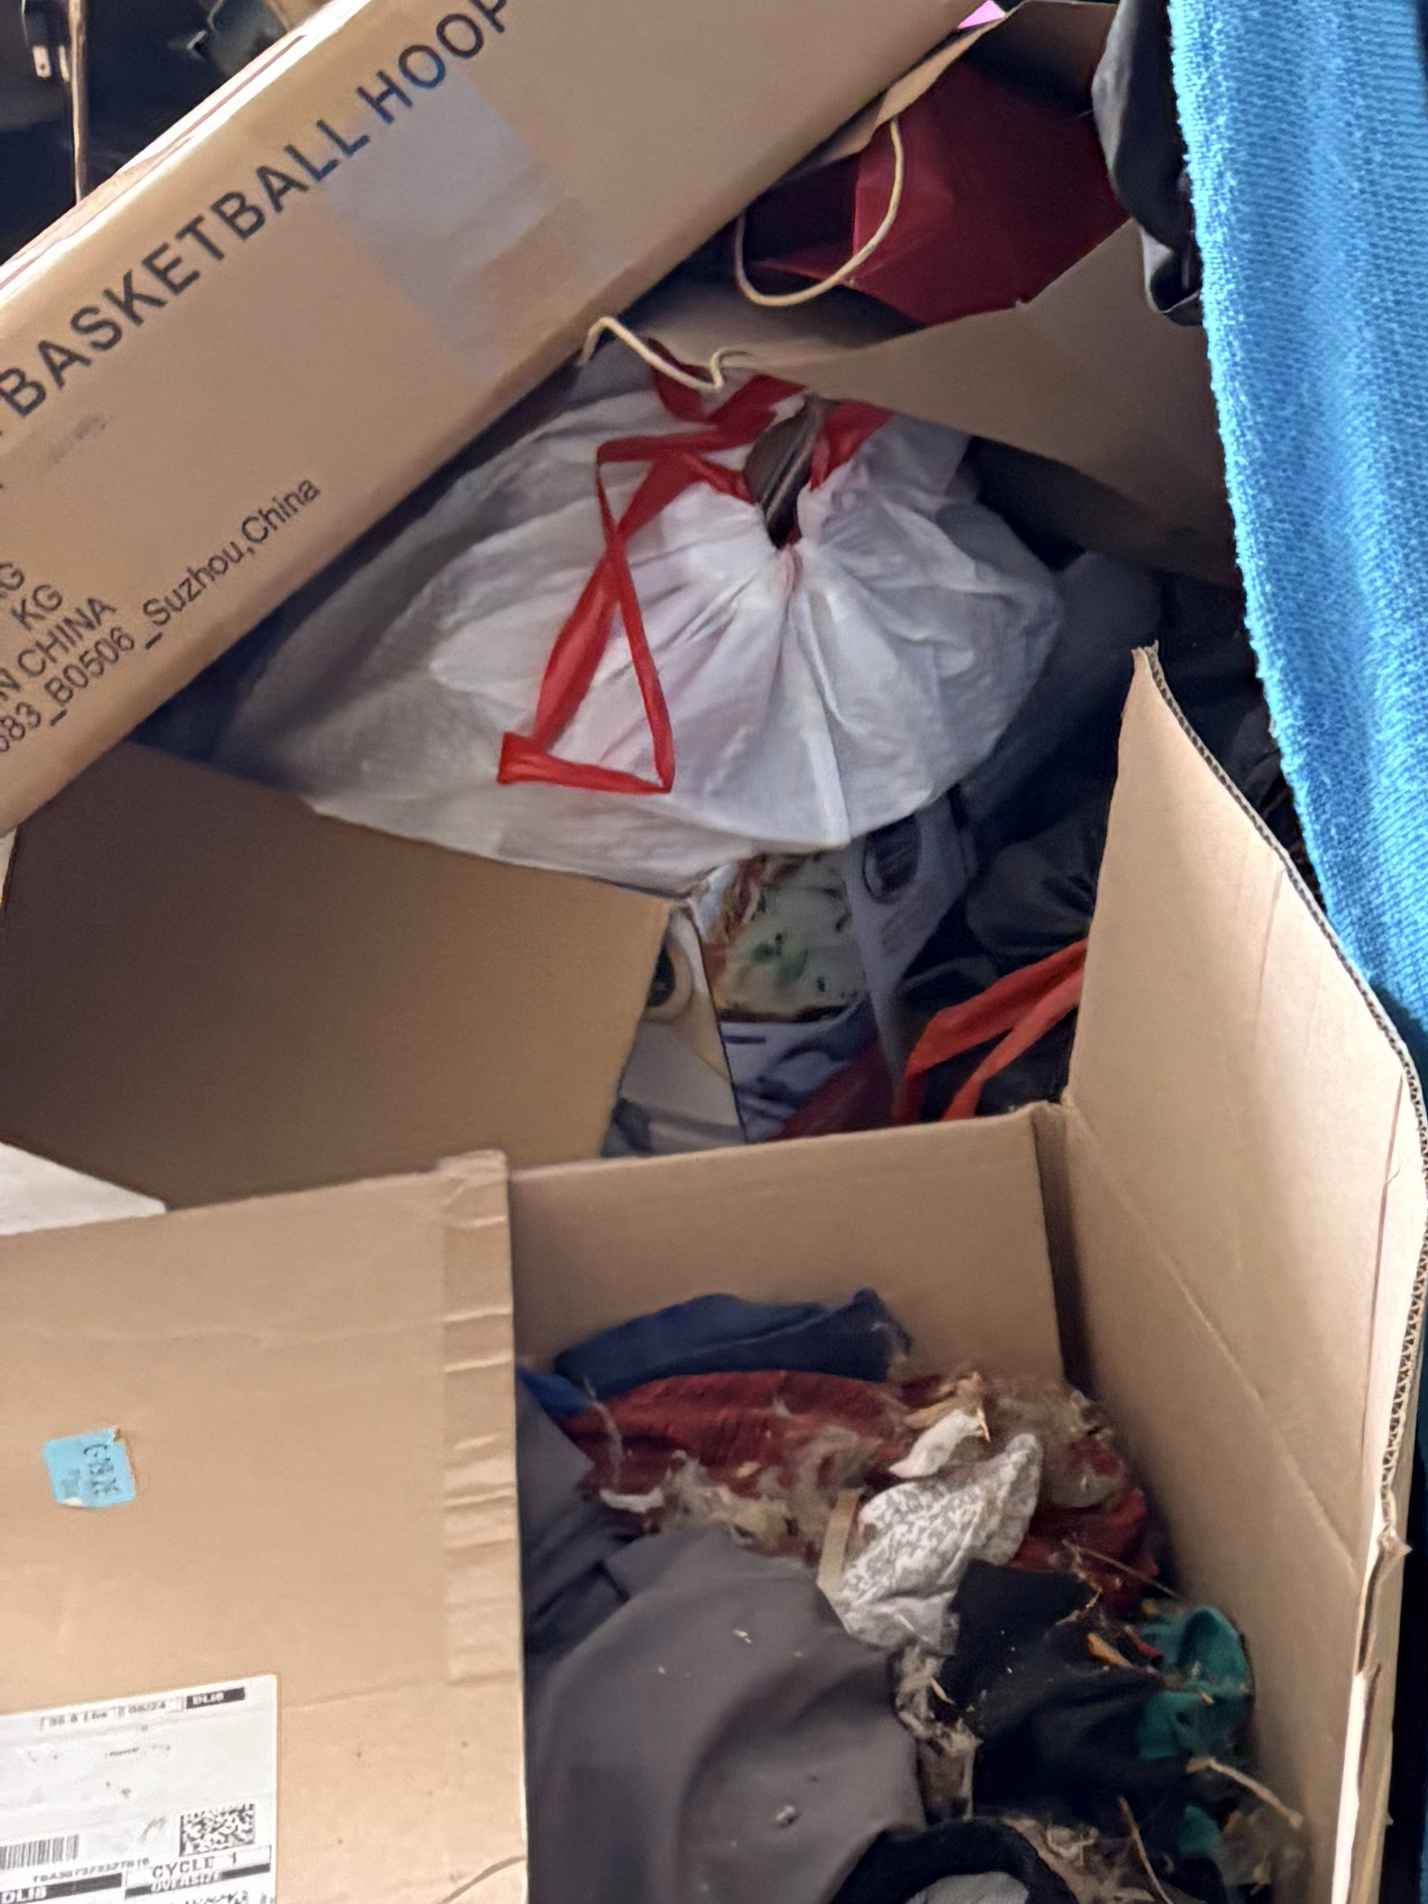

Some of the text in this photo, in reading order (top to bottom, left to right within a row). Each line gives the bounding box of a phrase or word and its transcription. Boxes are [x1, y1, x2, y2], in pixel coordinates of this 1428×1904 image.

[0, 119, 371, 416] BASKETBALL
[11, 584, 63, 631] KG
[17, 598, 116, 677] CHINA
[152, 1855, 215, 1880] CYCLE
